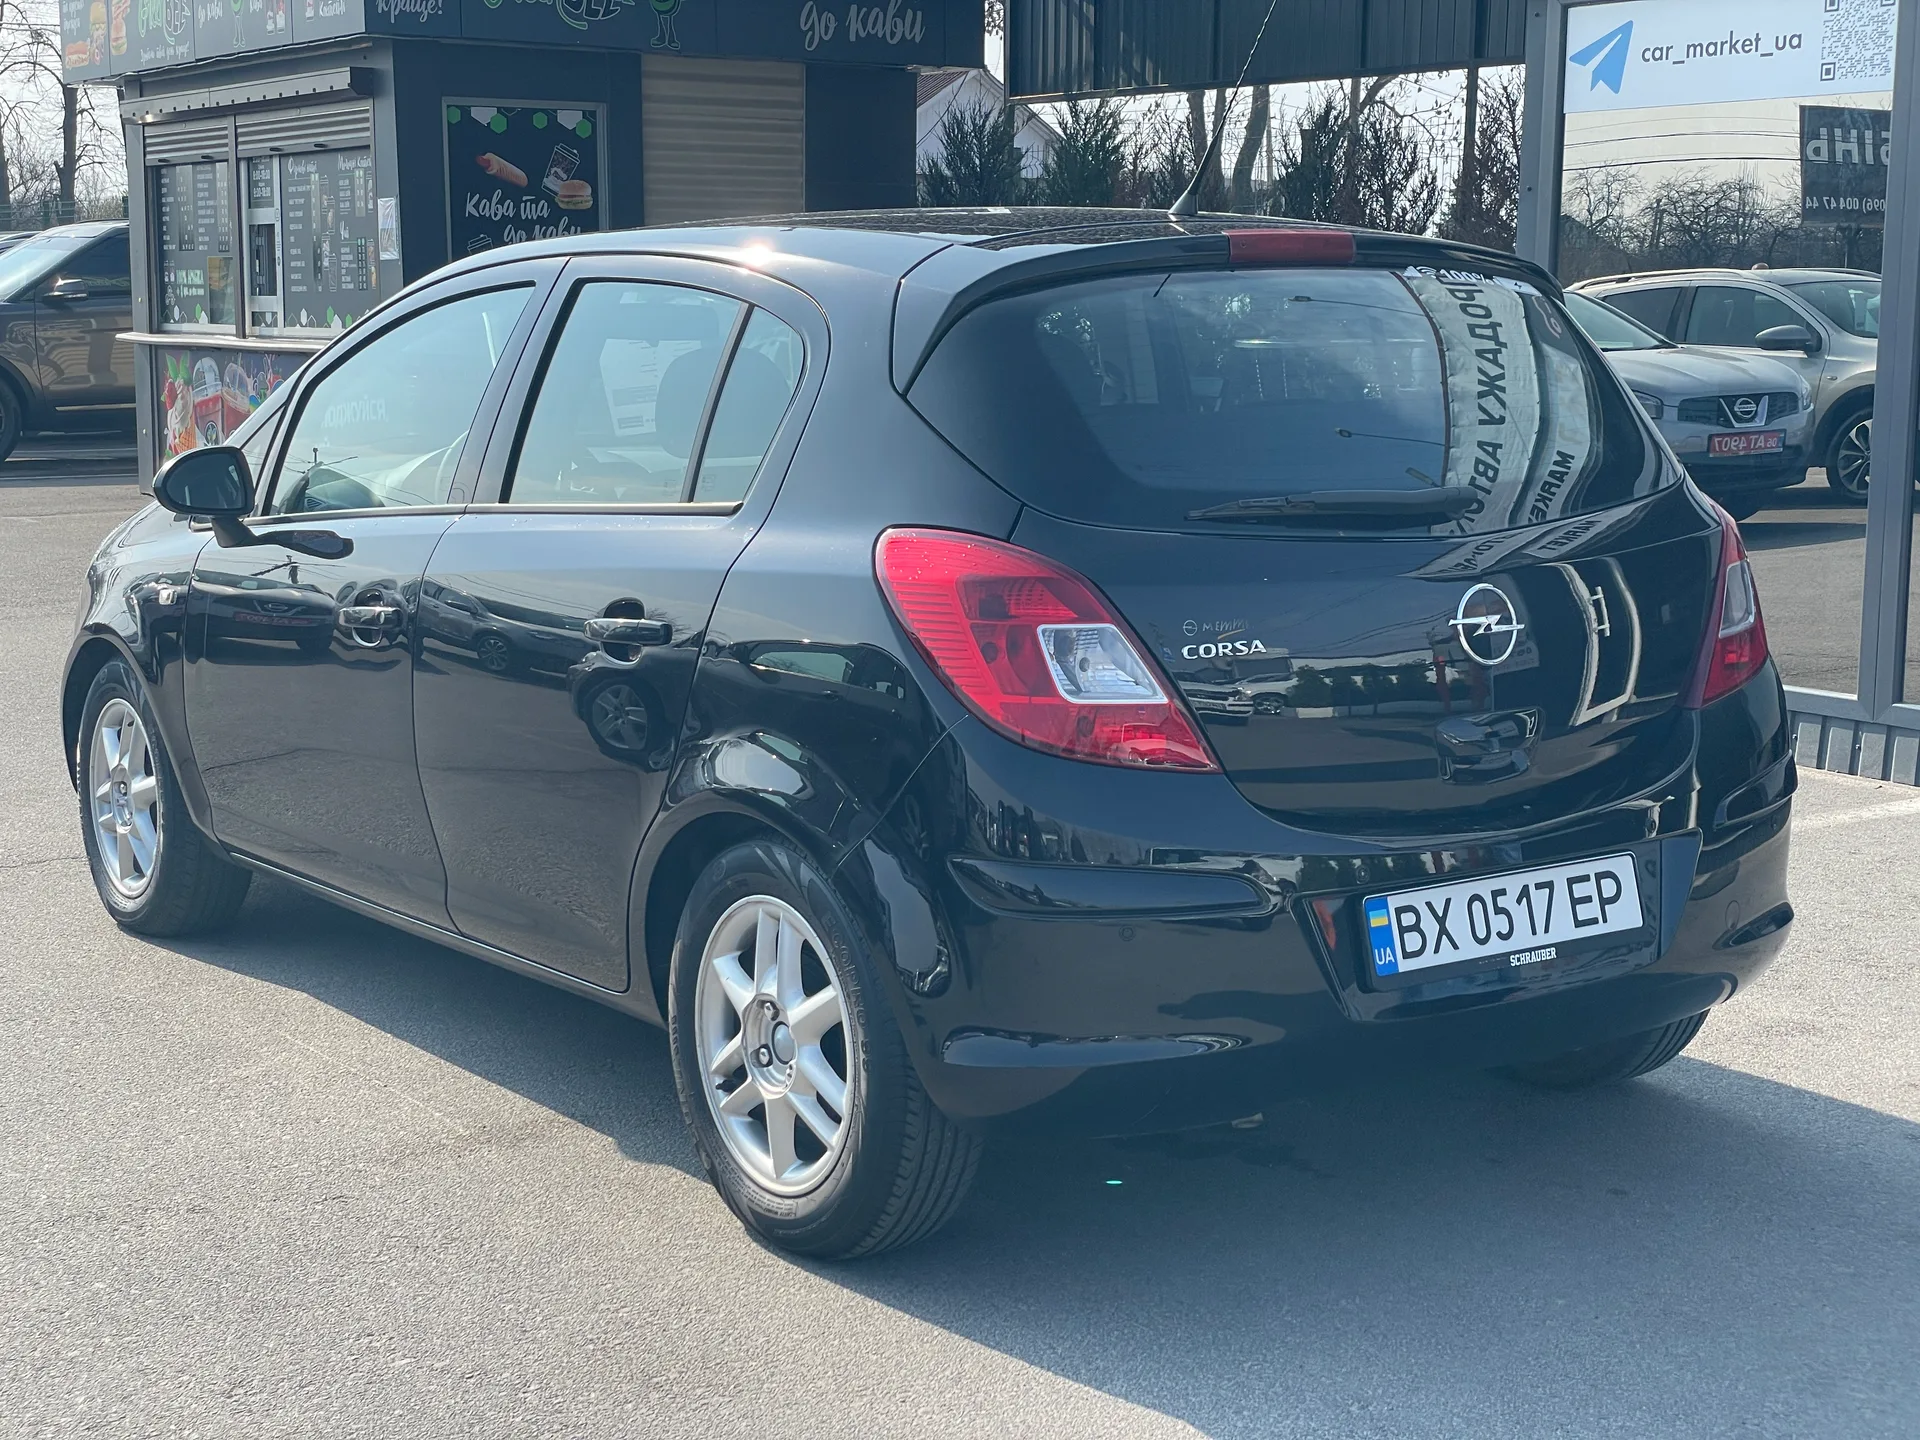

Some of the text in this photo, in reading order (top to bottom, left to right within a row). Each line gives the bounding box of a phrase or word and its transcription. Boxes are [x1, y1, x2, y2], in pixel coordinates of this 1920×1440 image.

[800, 0, 926, 51] до кави
[1641, 30, 1803, 65] car_market_ua
[466, 189, 516, 221] Кава
[1181, 640, 1267, 660] CORSA
[1394, 870, 1623, 960] BX 0517 EP
[1375, 947, 1395, 965] UA
[1509, 947, 1557, 967] SCHRAUBER
